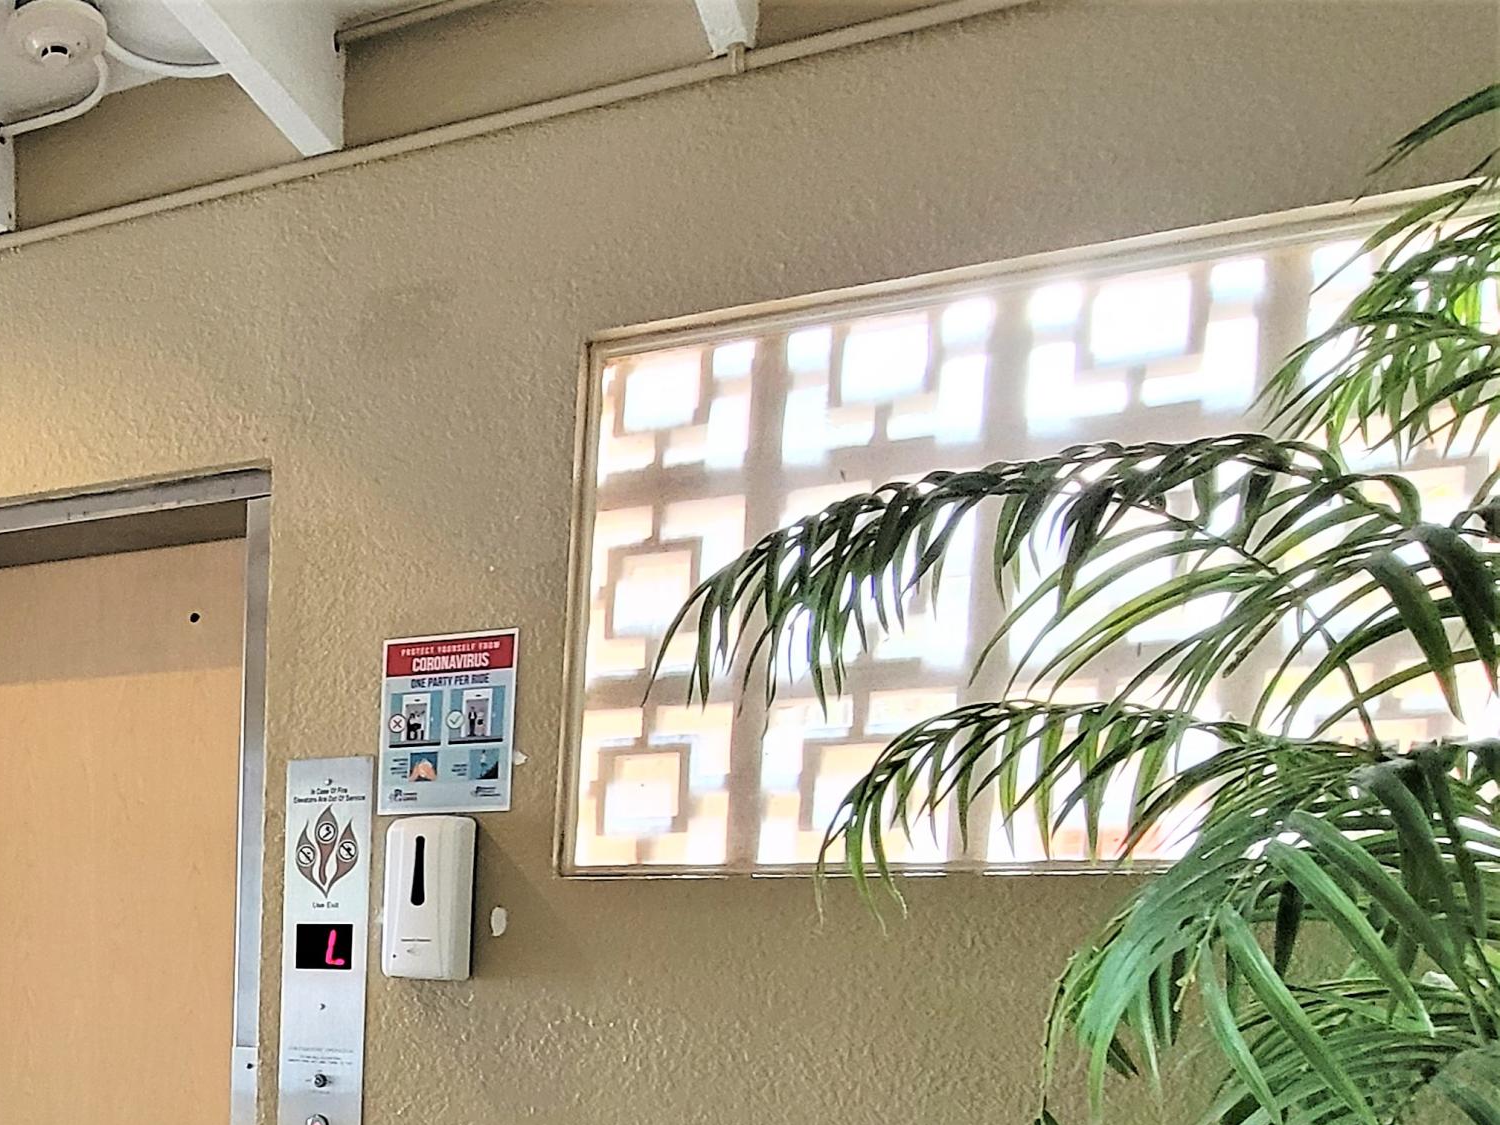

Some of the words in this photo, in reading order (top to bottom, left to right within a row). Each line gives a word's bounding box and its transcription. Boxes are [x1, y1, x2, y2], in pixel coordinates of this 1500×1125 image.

[401, 646, 435, 656] PROTECT
[438, 643, 475, 653] YOURSELF
[478, 640, 501, 650] FROM
[412, 652, 490, 672] CORONAVIRUS
[411, 678, 427, 689] ONE
[428, 676, 453, 688] PARTY
[454, 674, 470, 686] PER
[471, 672, 491, 684] RIDE
[325, 928, 346, 966] L
